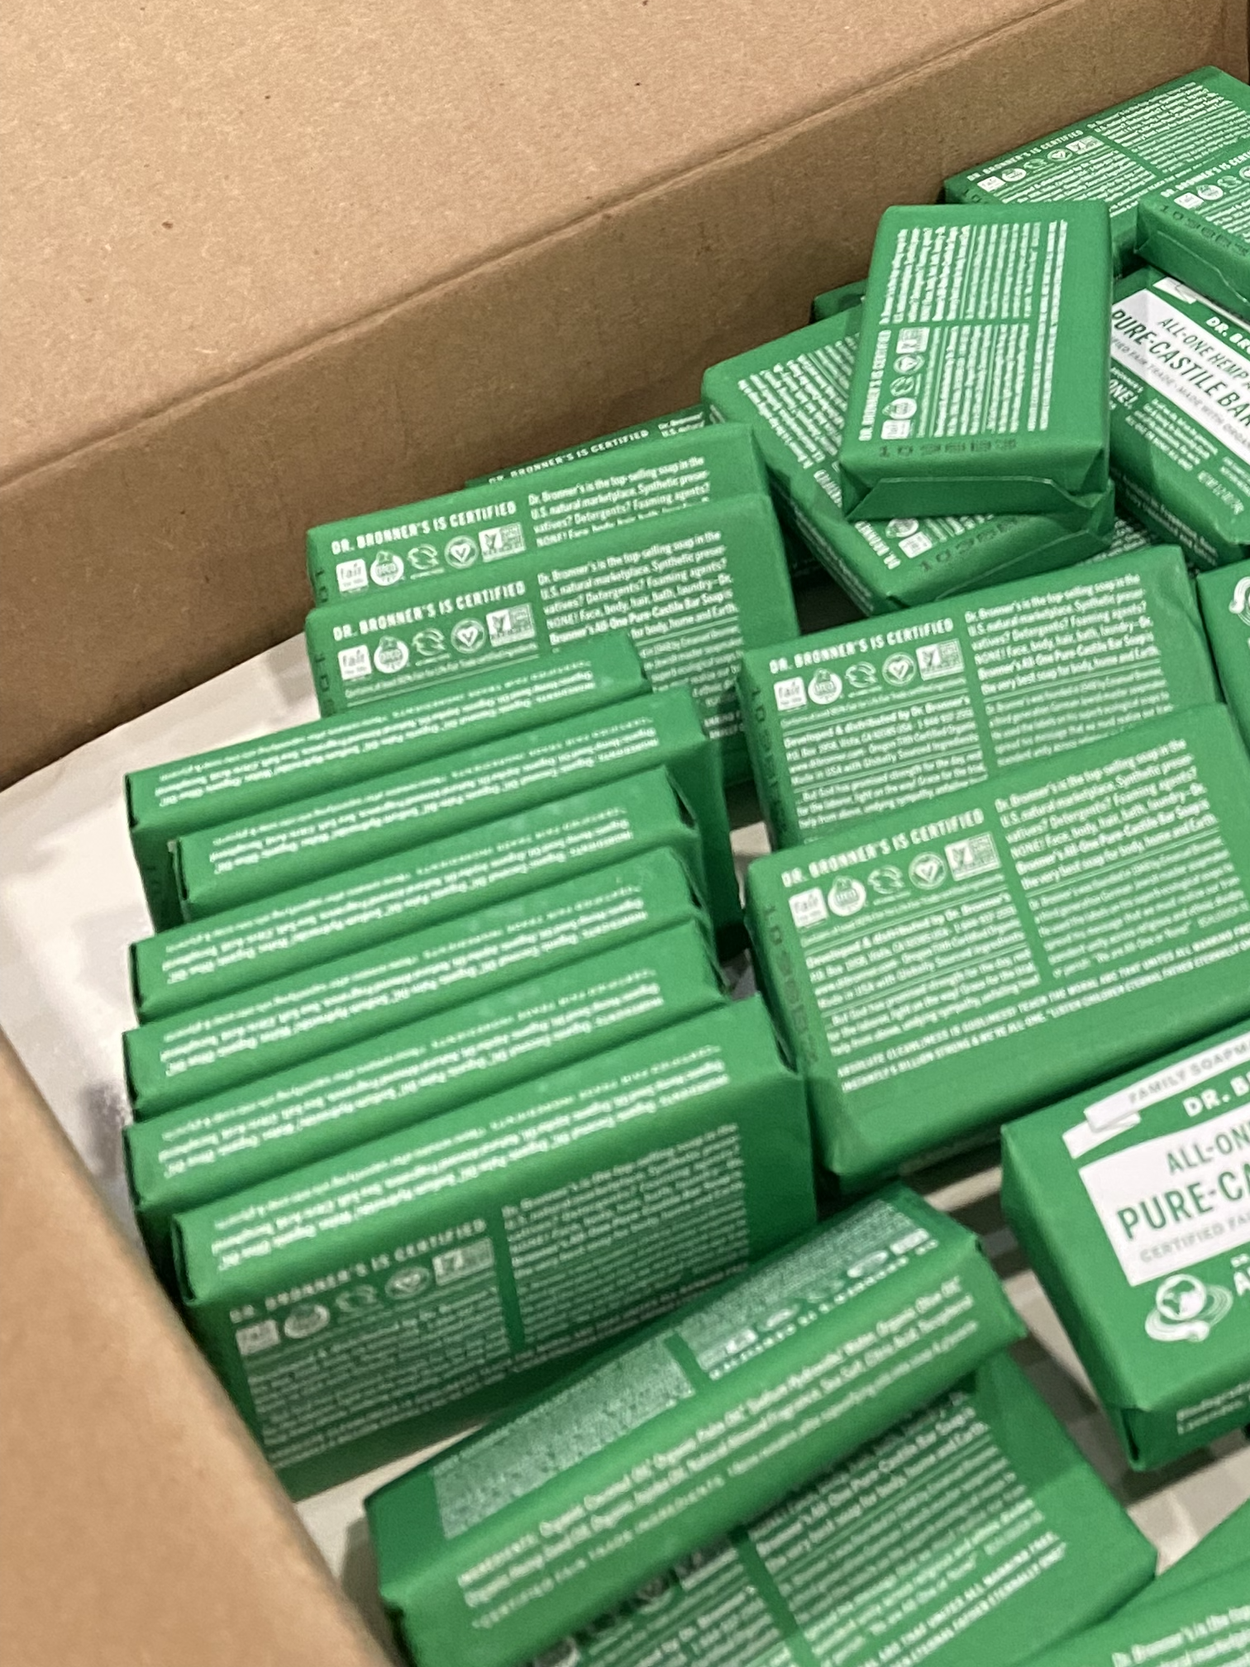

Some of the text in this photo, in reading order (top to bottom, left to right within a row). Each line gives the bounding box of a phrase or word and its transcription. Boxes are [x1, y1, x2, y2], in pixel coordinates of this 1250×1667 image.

[1111, 308, 1228, 398] PURE-CASTILE
[1157, 317, 1215, 357] ALL-ONE
[1206, 352, 1250, 379] HEMP
[1204, 316, 1229, 337] DR.
[527, 456, 704, 506] Dr. Bronner's is the top-selling soap in the
[330, 500, 517, 555] DR. BRONNER'S IS CERTIFIED
[332, 580, 526, 641] DR. BRONNER'S IS CERTIFIED
[768, 617, 954, 674] DR. BRONNER'S IS CERTIFIED
[780, 807, 985, 888] DR. BRONNER'S IS CERTIFIED
[1126, 1068, 1187, 1105] FAMILY
[1181, 1087, 1231, 1117] DR.
[1139, 1221, 1224, 1264] CERTIFIED
